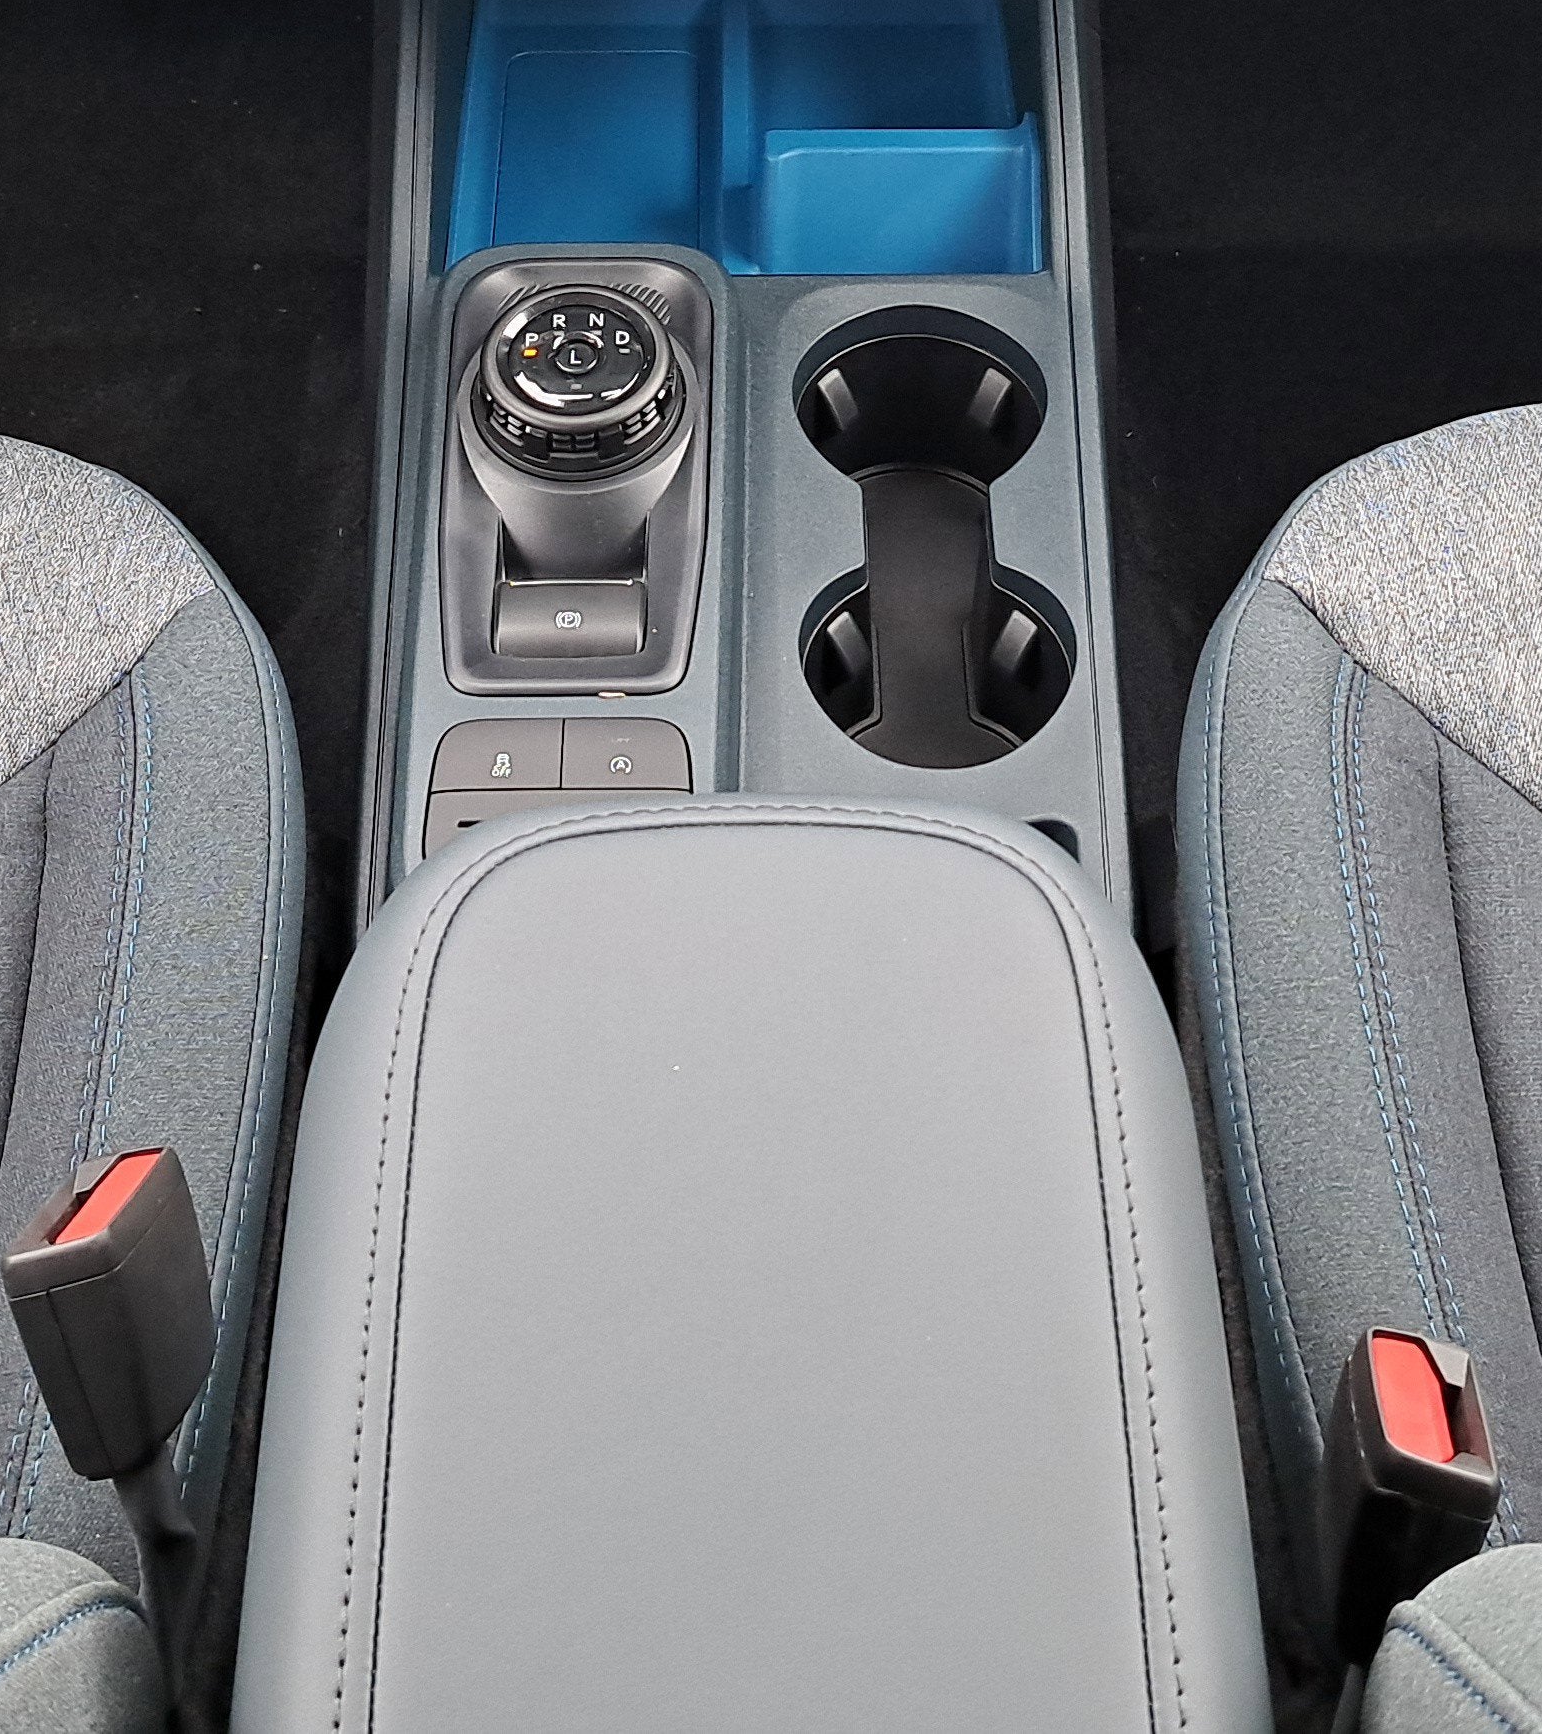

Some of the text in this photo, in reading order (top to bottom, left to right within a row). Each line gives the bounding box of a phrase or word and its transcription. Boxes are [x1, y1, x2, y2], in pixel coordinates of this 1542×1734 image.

[525, 312, 630, 347] P R N D
[570, 349, 582, 365] L
